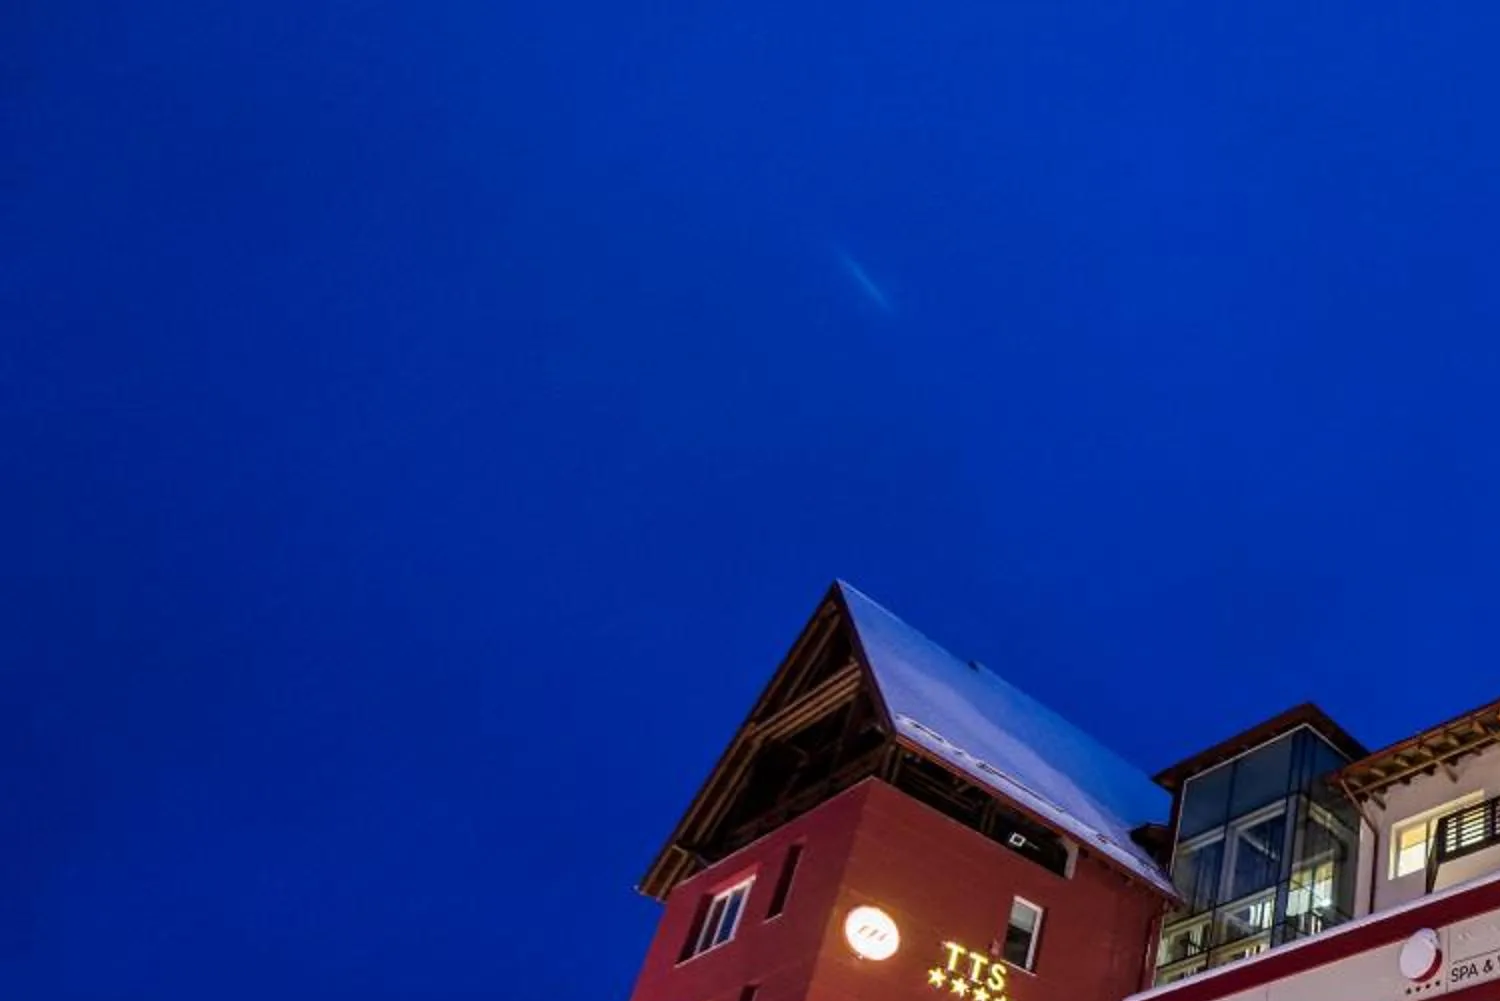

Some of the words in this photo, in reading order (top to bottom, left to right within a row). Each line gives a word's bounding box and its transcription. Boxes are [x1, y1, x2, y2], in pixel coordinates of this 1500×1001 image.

[942, 940, 1007, 991] TTS
[1450, 960, 1479, 983] SPA
[1482, 959, 1494, 974] &
